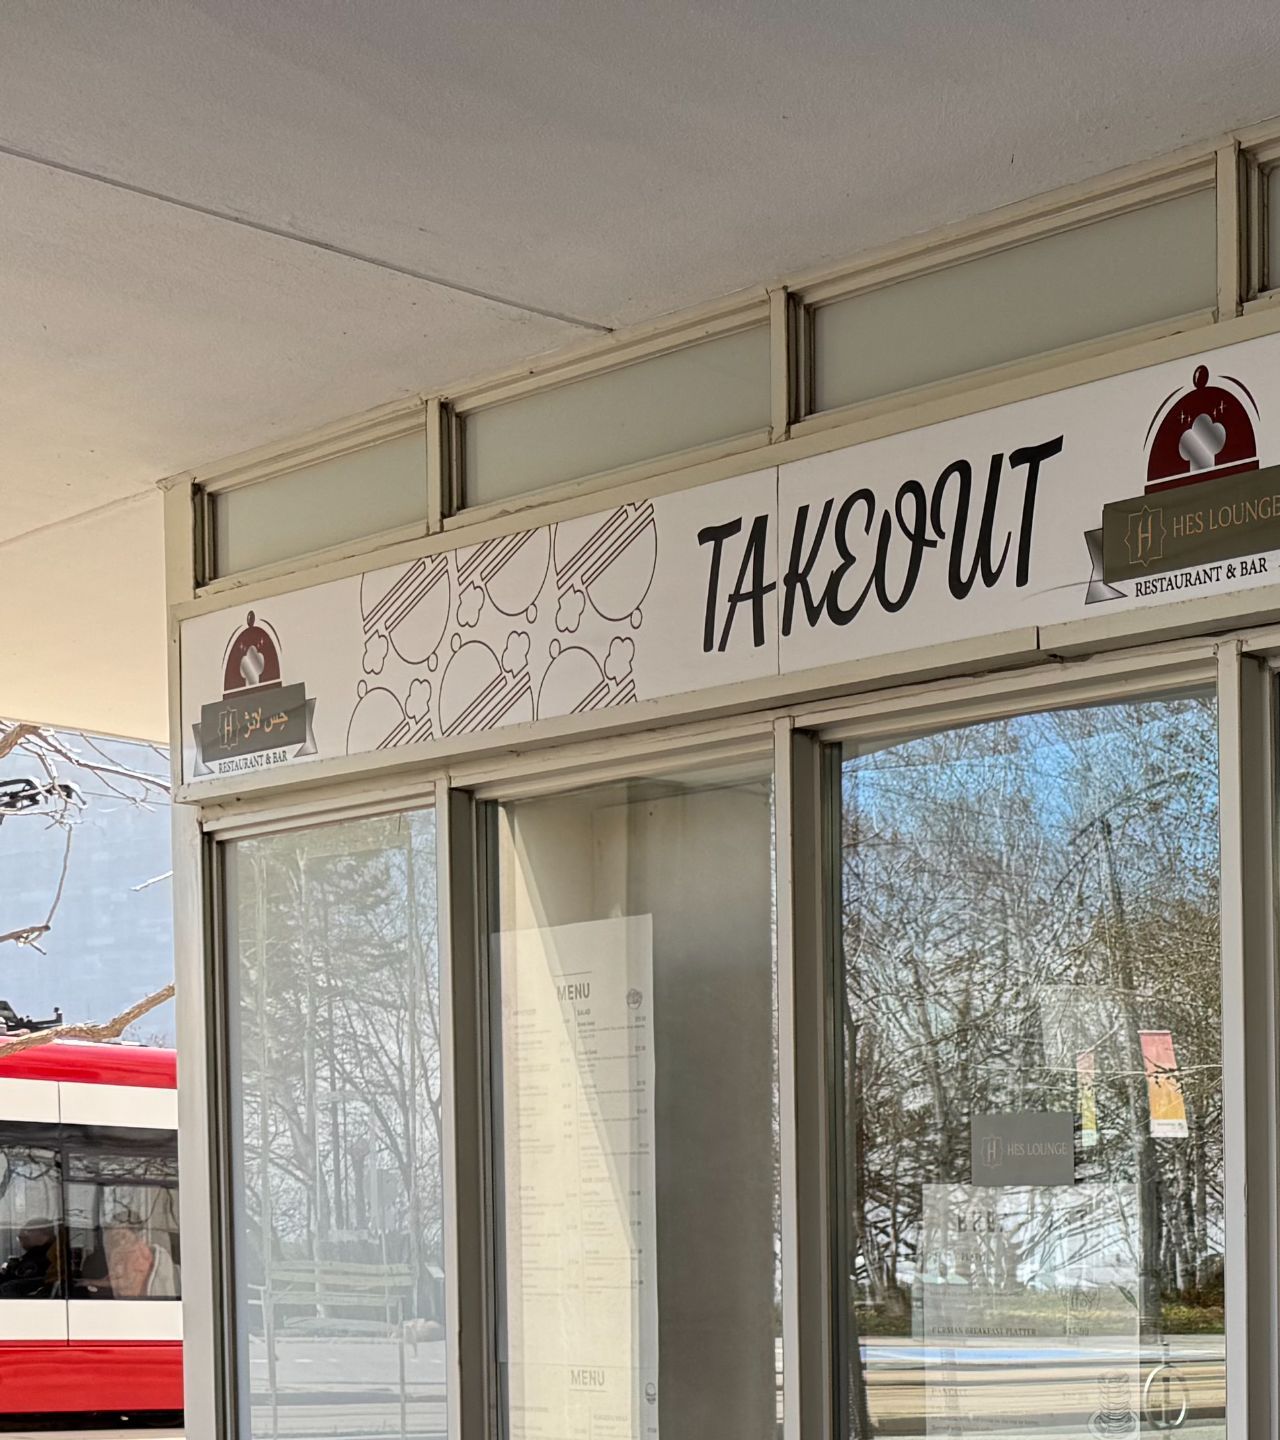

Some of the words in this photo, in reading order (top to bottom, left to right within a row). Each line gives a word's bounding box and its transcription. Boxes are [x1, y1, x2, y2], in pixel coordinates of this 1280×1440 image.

[1173, 511, 1204, 538] HES
[696, 435, 1064, 654] TAKEOUT
[1135, 563, 1223, 598] RESTAURANT
[1226, 562, 1237, 578] &
[1240, 557, 1268, 577] BAR
[218, 755, 265, 774] RESTAURANT
[265, 753, 272, 764] &
[273, 750, 288, 764] BAR
[556, 981, 591, 1001] MENU
[1007, 1143, 1024, 1156] HES
[1027, 1141, 1067, 1156] LOUNGE
[570, 1368, 606, 1388] MENU
